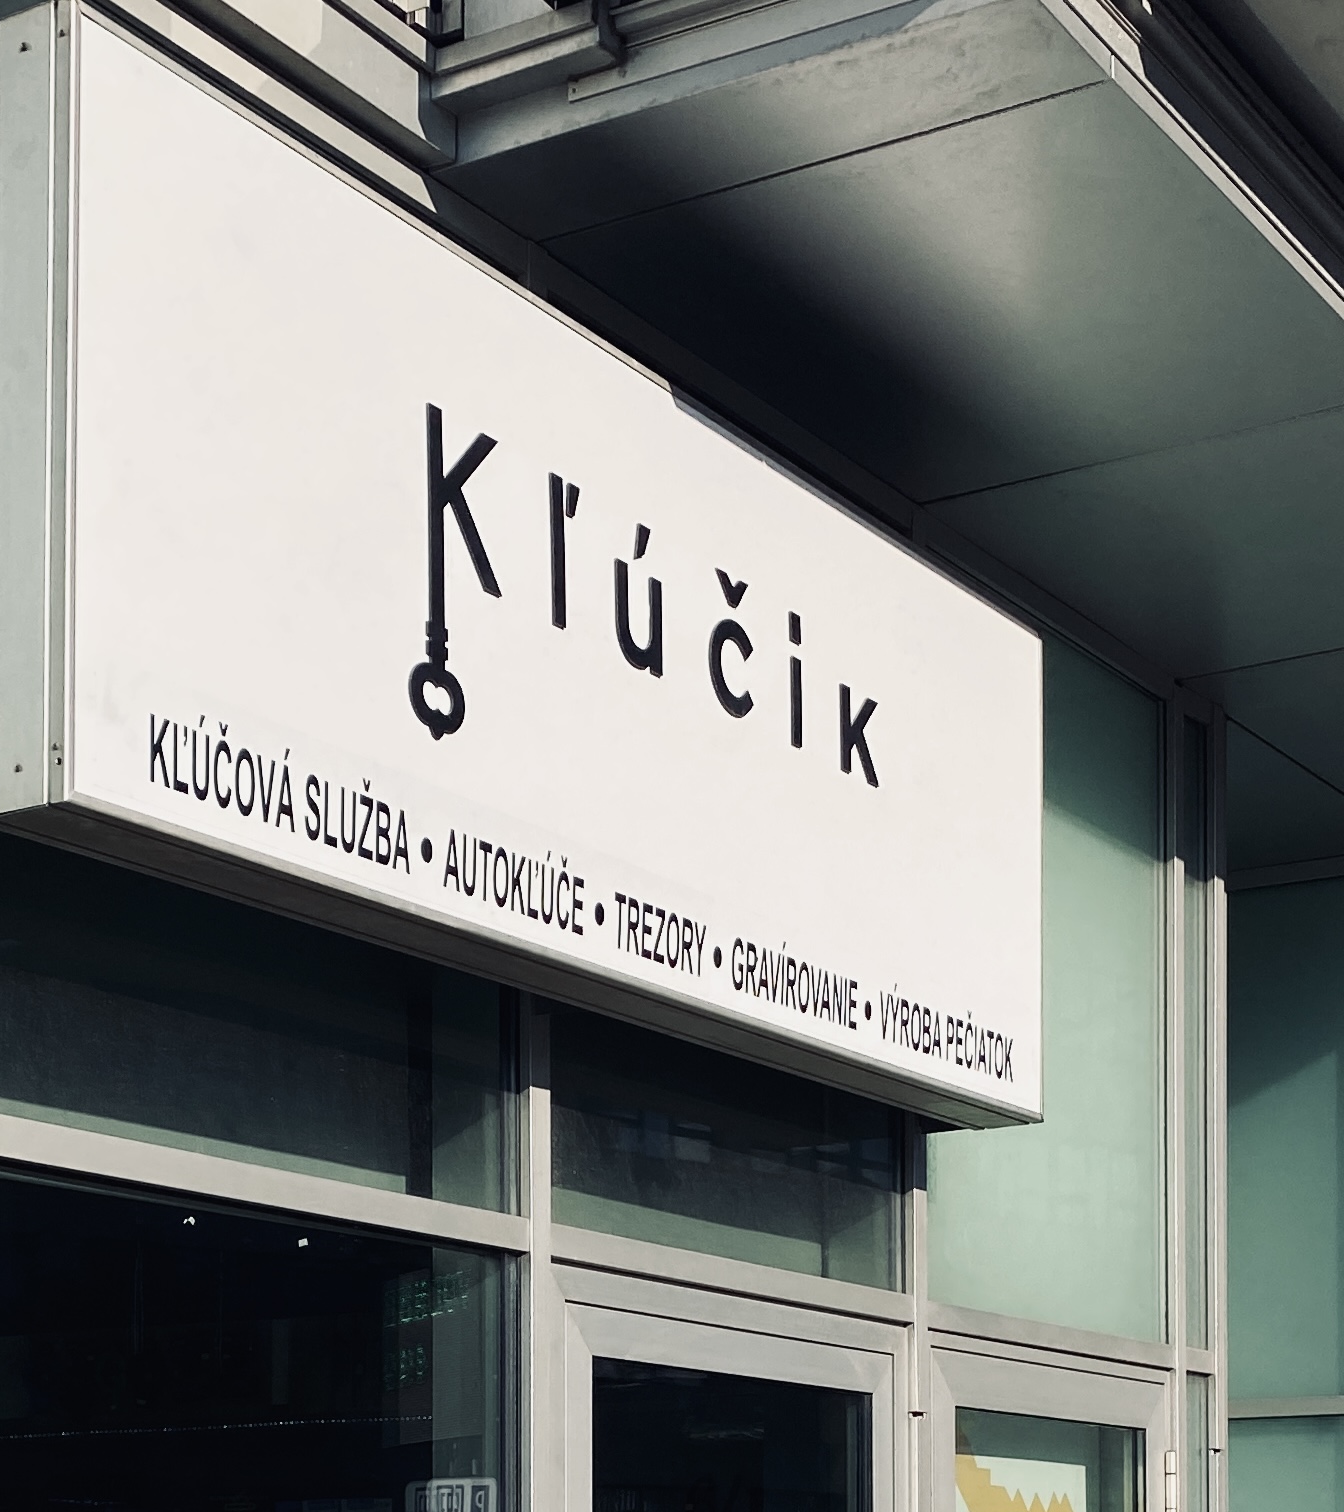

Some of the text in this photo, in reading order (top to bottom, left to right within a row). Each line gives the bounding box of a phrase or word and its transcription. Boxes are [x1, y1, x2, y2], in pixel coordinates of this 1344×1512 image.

[408, 402, 880, 788] Kľúčik
[148, 712, 1015, 1084] KĽÚČOVÁ SLUŽBA AUTOKĽÚČE TREZORY GRAVÍROVANIE VÝROBA PEČIATOK
